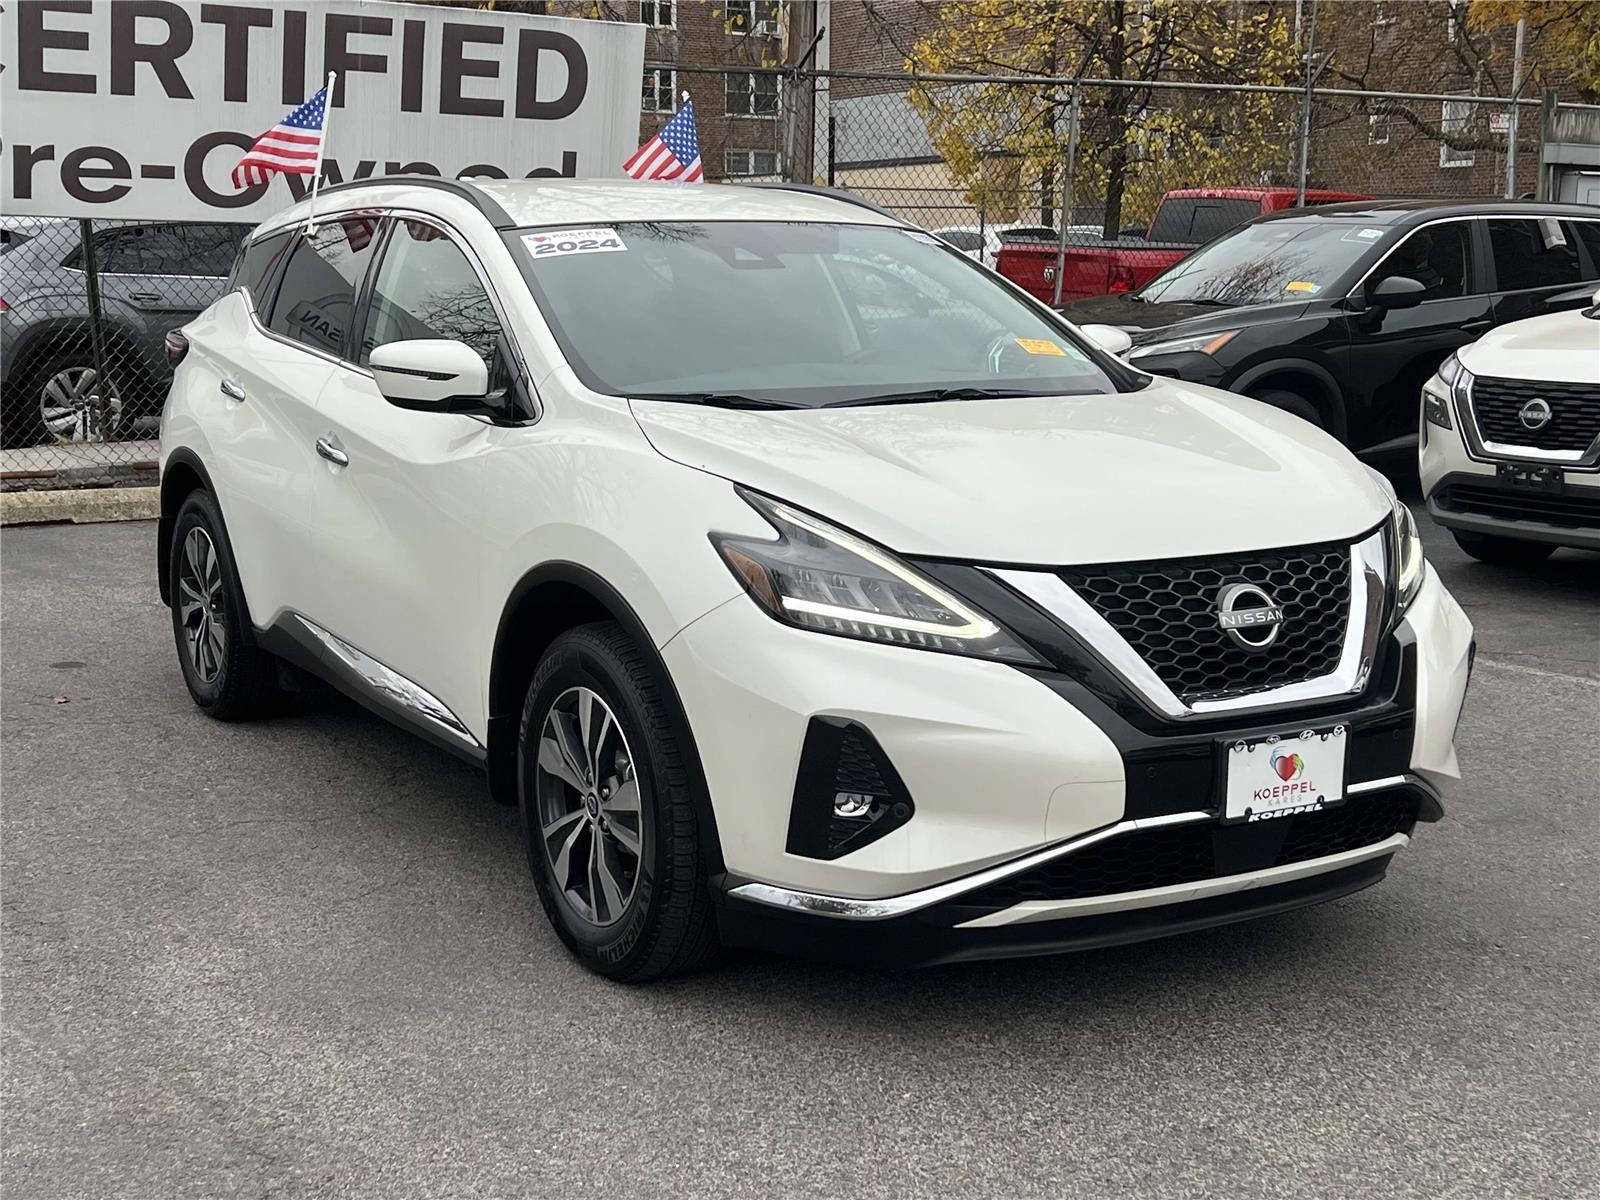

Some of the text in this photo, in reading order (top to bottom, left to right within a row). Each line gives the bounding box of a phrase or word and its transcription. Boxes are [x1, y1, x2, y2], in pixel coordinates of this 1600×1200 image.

[0, 0, 588, 120] ERTIFIED
[535, 238, 620, 255] 2024
[1221, 609, 1284, 626] NISSAN
[1253, 780, 1317, 801] KOEPPEL
[1248, 803, 1323, 822] KOEPPEL
